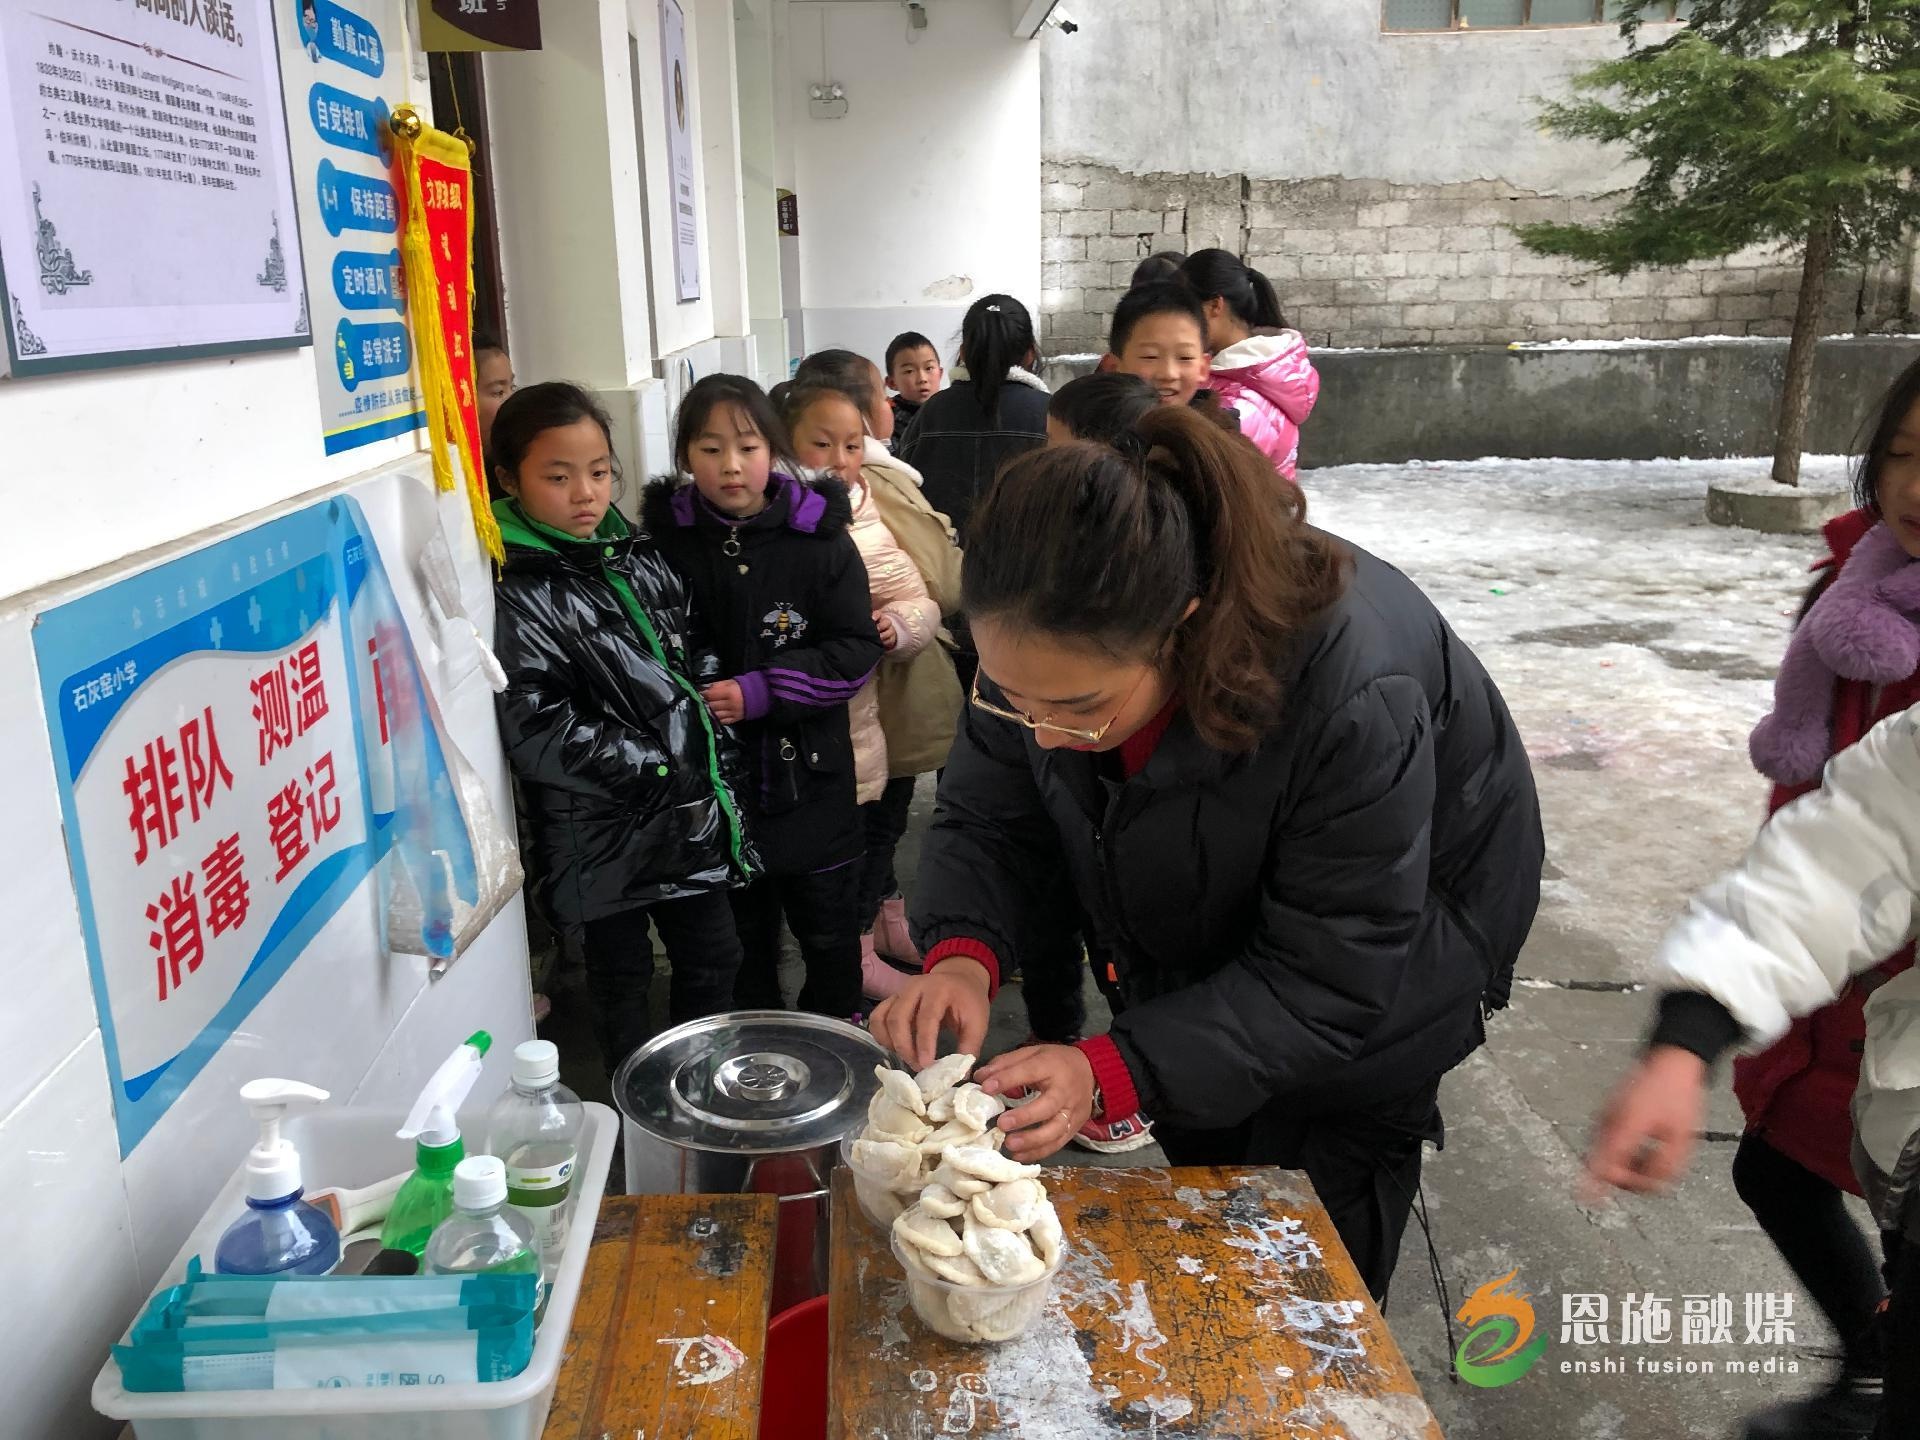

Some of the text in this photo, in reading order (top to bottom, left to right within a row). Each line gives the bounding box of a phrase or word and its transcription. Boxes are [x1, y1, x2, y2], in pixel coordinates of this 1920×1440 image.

[330, 16, 381, 66] 勤戴口罩
[317, 97, 368, 140] 自觉排队
[350, 187, 396, 221] 保持距离
[342, 265, 387, 296] 定时通风
[362, 335, 402, 367] 经常洗手
[73, 659, 138, 713] 石灰窑小学
[122, 706, 234, 866] 排队
[250, 640, 330, 767] 测温
[145, 751, 342, 1001] 消毒 登记
